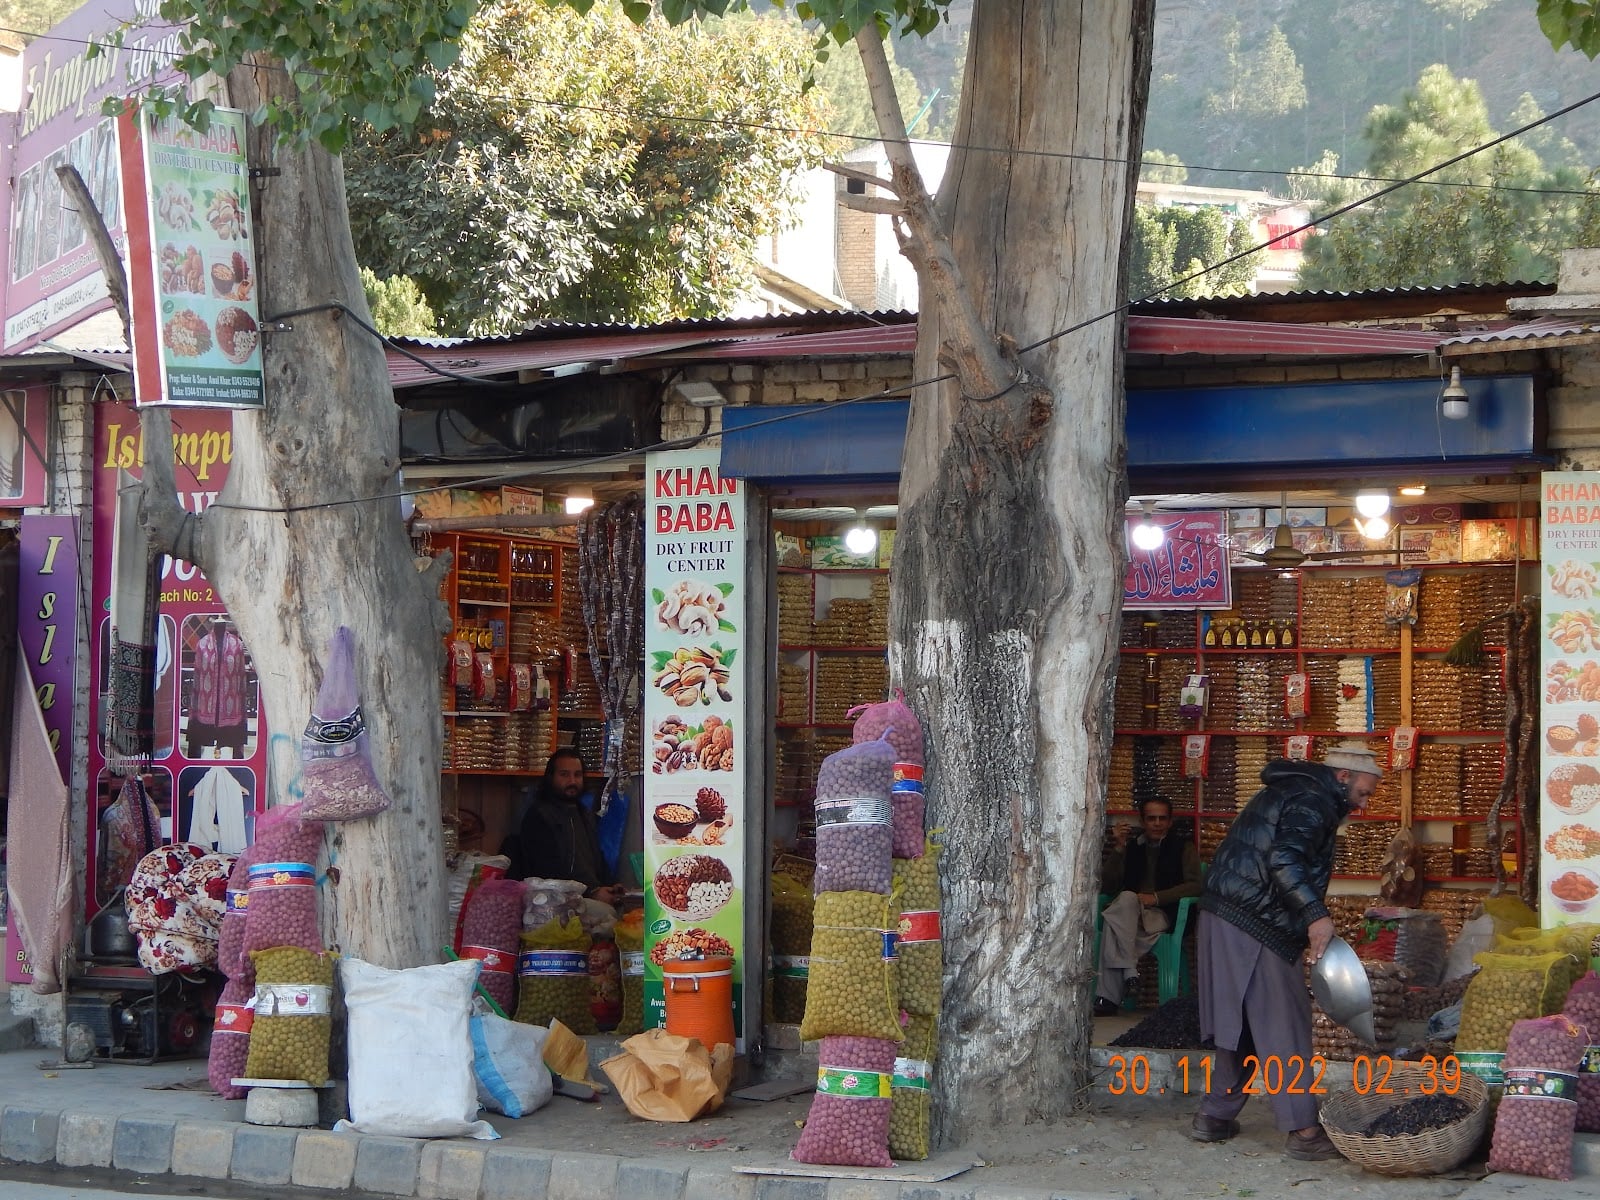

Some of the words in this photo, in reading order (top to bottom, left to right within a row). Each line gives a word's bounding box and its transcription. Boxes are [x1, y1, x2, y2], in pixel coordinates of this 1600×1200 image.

[127, 28, 184, 86] House
[199, 120, 241, 156] BABA
[154, 151, 174, 167] DRY
[175, 154, 202, 170] FRUIT
[204, 159, 241, 176] CENTER
[654, 464, 738, 499] KHAN
[655, 500, 737, 536] BABA
[1546, 504, 1600, 526] BABA
[1547, 529, 1569, 539] DRY
[655, 542, 686, 556] DRY
[690, 539, 734, 555] FRUIT
[1555, 540, 1598, 550] CENTER
[667, 557, 726, 573] CENTER
[160, 588, 180, 603] ach
[183, 588, 203, 602] No:
[205, 588, 213, 602] 2
[650, 997, 666, 1007] Awa
